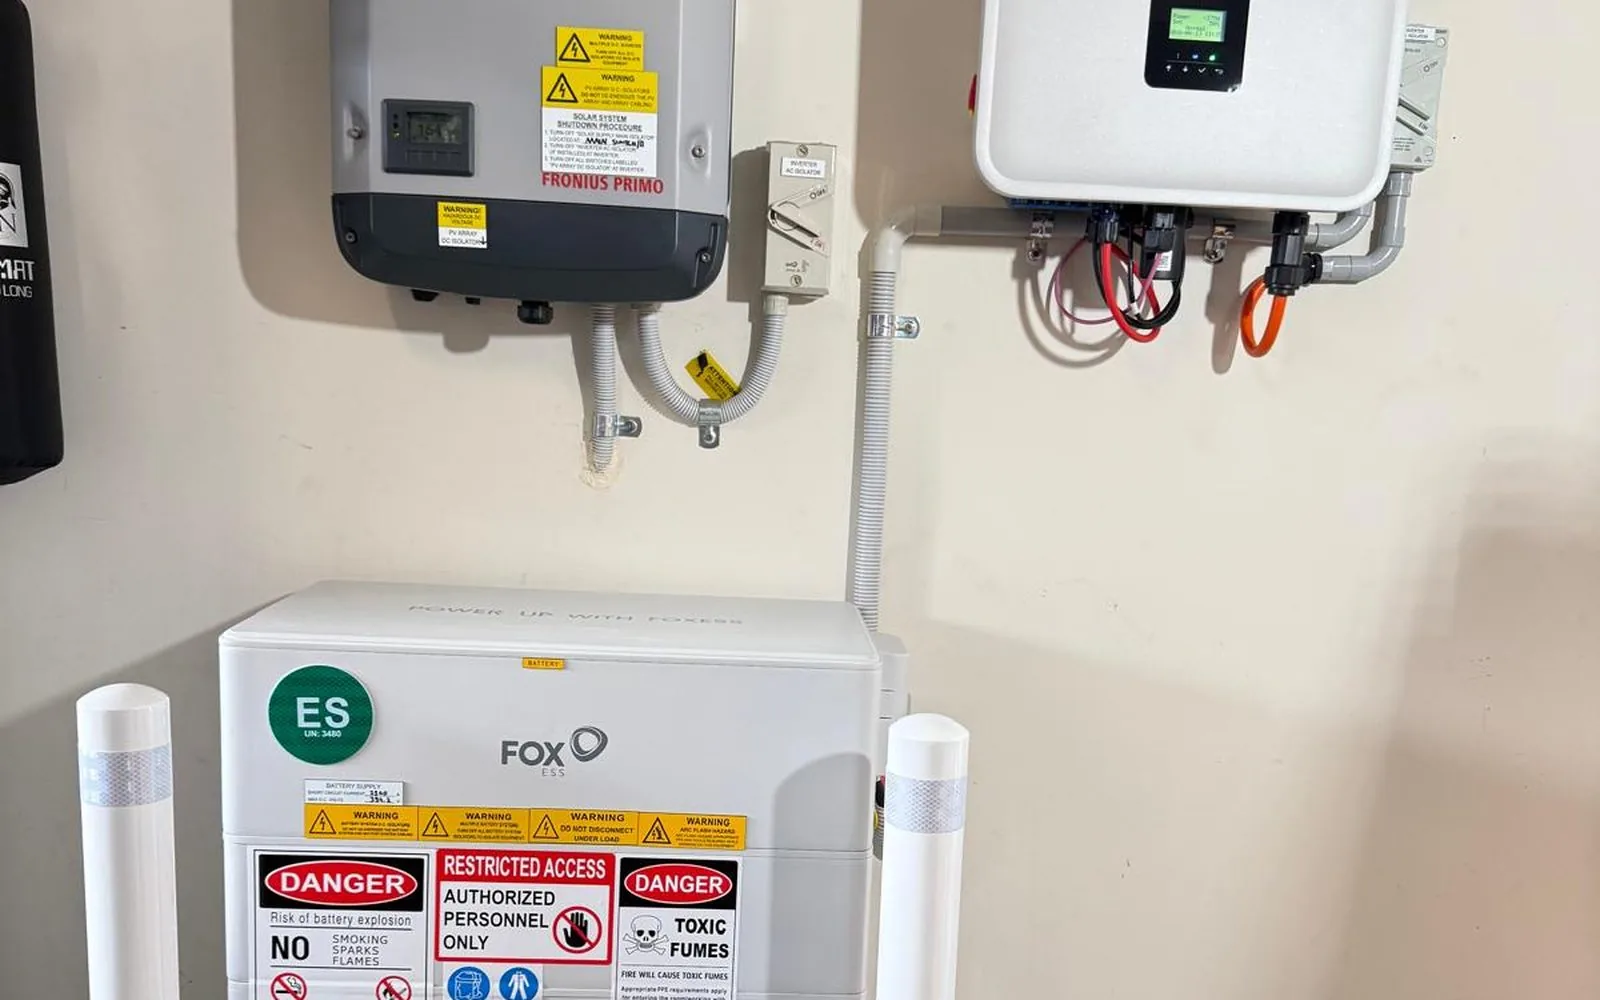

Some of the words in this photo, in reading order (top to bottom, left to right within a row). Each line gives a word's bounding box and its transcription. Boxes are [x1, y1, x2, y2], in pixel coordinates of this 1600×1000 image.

[601, 74, 635, 82] WARNING
[573, 113, 597, 121] SOLAR
[558, 120, 598, 129] SHUTDOWN
[600, 124, 642, 132] PROCEDURE
[790, 160, 817, 168] INVERTER
[542, 172, 608, 190] FRONIUS
[614, 176, 664, 194] PRIMO
[2, 284, 32, 298] LONG
[408, 605, 502, 616] POWER
[568, 614, 634, 622] WITH
[648, 616, 744, 625] FOXESS
[528, 659, 560, 668] BATTERY
[296, 696, 350, 729] ES
[304, 730, 320, 738] UN:
[321, 730, 342, 738] 3480
[501, 740, 566, 767] FOX
[542, 768, 566, 777] ESS
[353, 811, 399, 820] WARNING
[465, 812, 512, 820] WARNING
[570, 812, 625, 822] WARNING
[686, 817, 730, 826] WARNING
[589, 826, 633, 834] DISCONNECT
[444, 855, 541, 878] RESTRICTED
[544, 859, 606, 879] ACCESS
[280, 872, 405, 894] DANGER
[635, 874, 724, 894] DANGER
[444, 889, 555, 906] AUTHORIZED
[270, 912, 294, 924] Risk
[298, 912, 310, 924] of
[313, 913, 354, 928] battery
[358, 914, 412, 929] explosion
[444, 912, 548, 928] PERSONNEL
[675, 918, 726, 936] TOXIC
[332, 934, 388, 945] SMOKING
[444, 935, 489, 951] ONLY
[271, 936, 310, 960] NO
[332, 945, 380, 956] SPARKS
[670, 942, 729, 959] FUMES
[332, 956, 380, 966] FLAMES
[621, 970, 636, 978] FIRE
[658, 971, 680, 979] CAUSE
[682, 972, 703, 980] TOXIC
[704, 972, 728, 980] FUMES
[710, 988, 727, 996] apply
